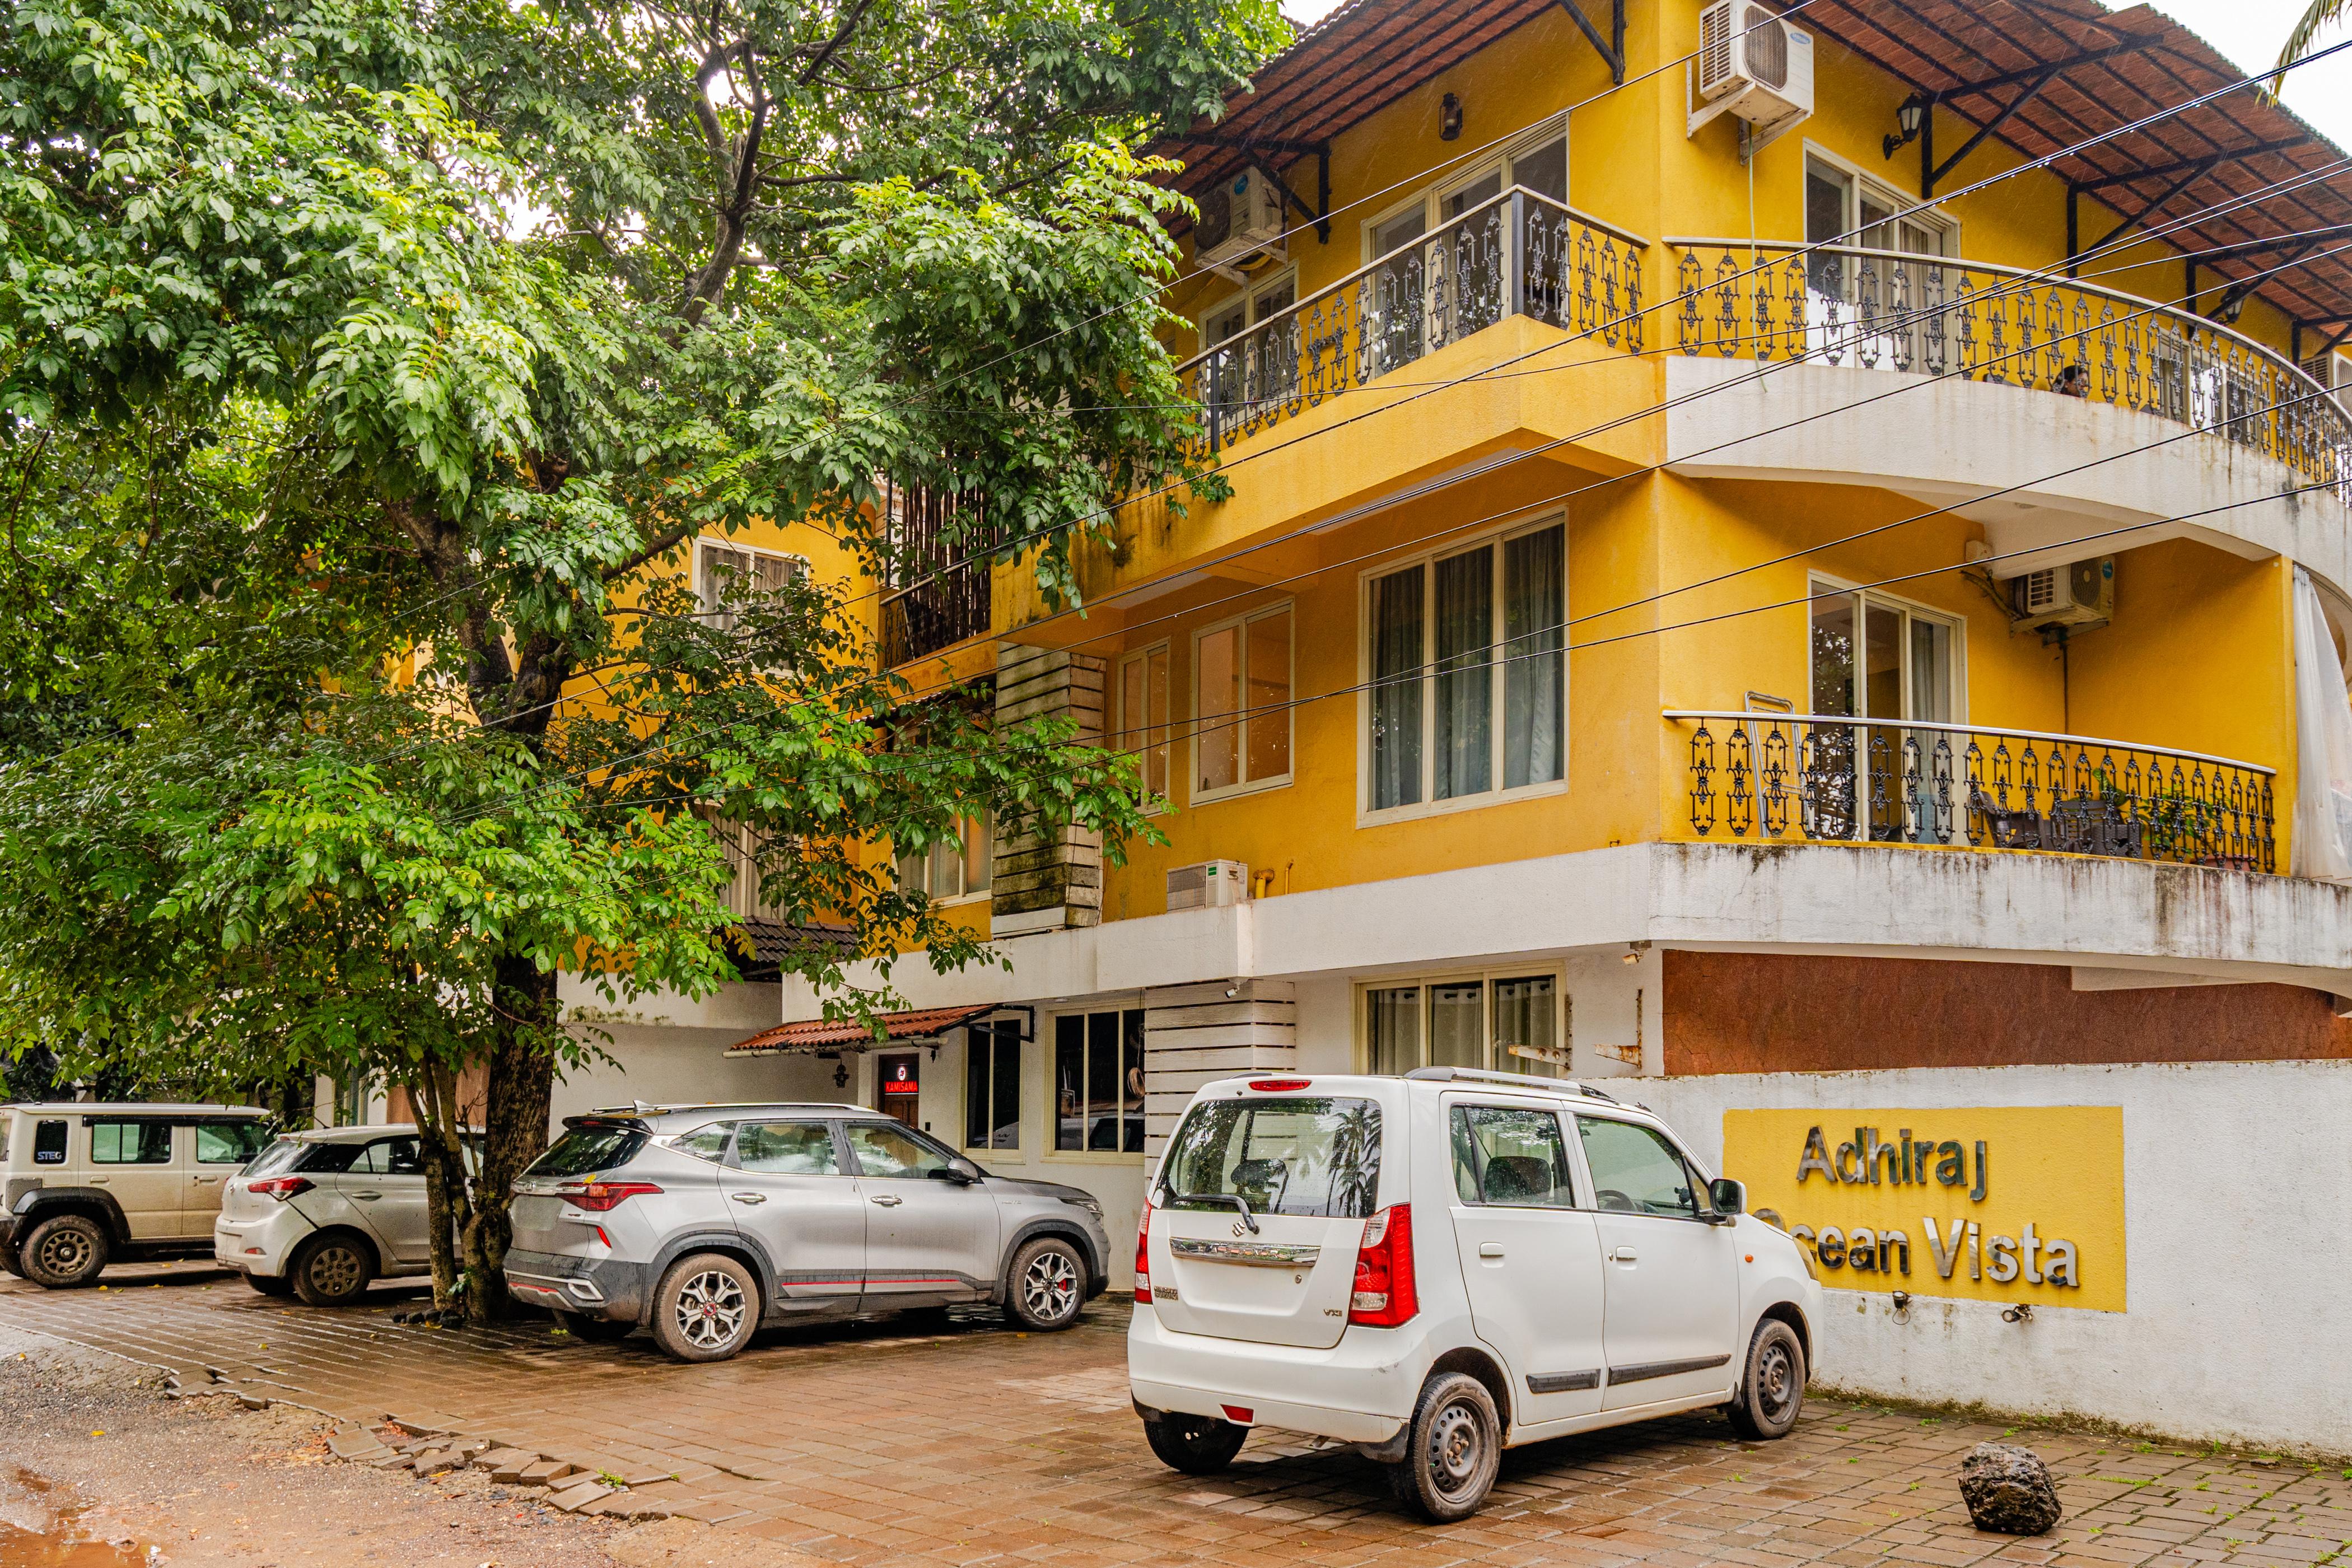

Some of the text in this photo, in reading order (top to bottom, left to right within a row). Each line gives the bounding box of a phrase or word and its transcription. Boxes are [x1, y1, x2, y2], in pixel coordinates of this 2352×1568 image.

[885, 1081, 918, 1093] KAMISAMA
[38, 1151, 62, 1160] STEG
[1796, 1125, 1987, 1201] Adhiraj
[1923, 1217, 2079, 1288] Vista
